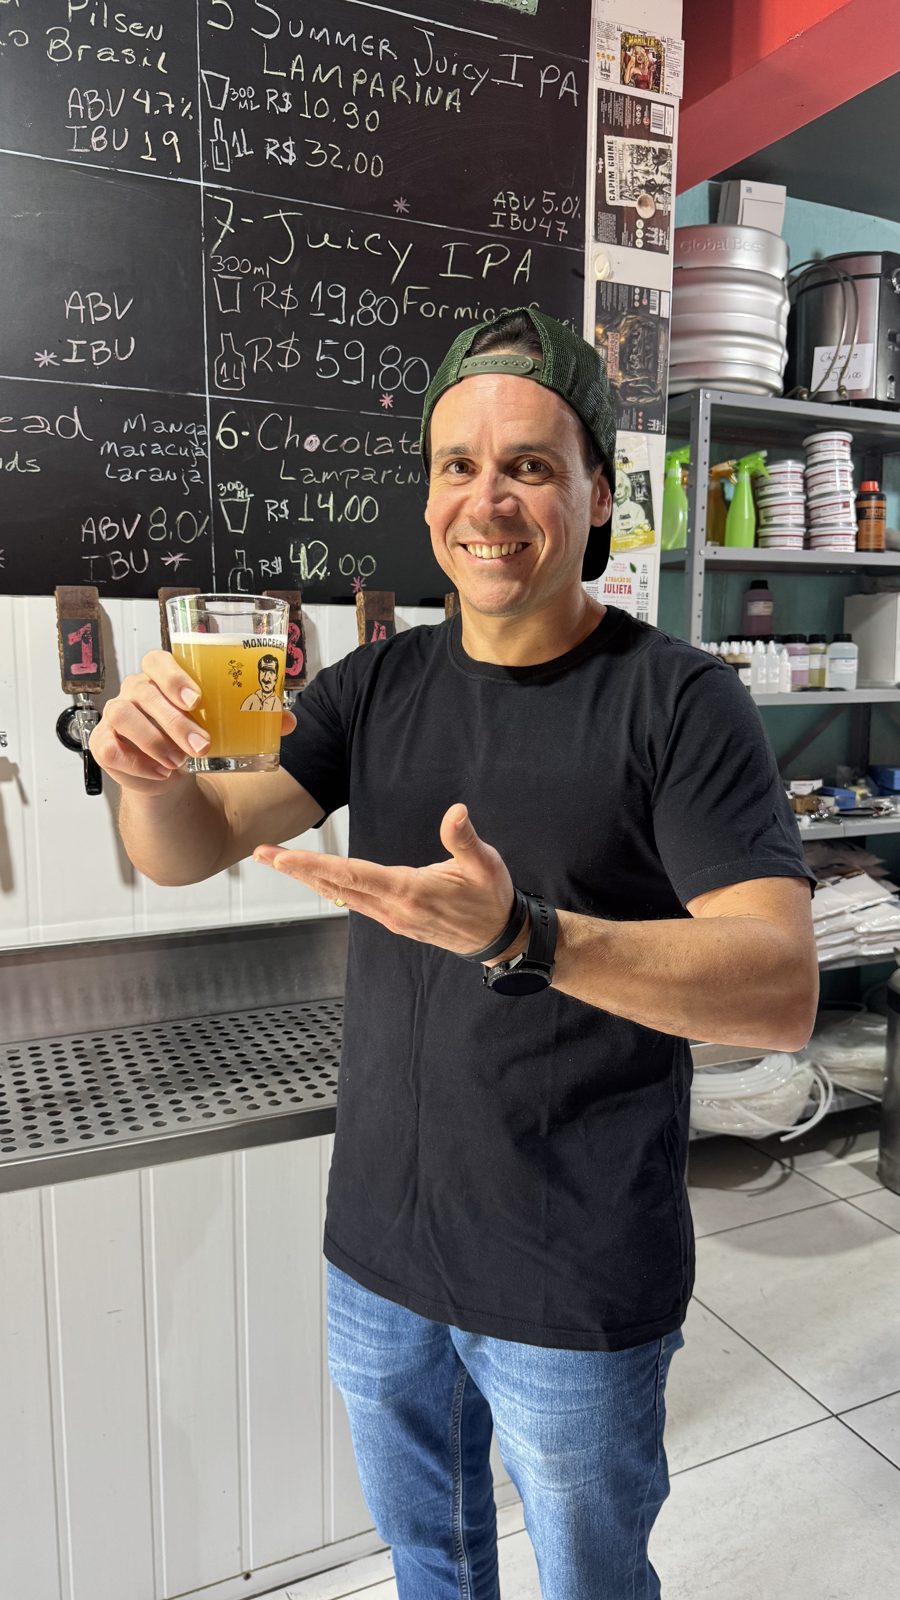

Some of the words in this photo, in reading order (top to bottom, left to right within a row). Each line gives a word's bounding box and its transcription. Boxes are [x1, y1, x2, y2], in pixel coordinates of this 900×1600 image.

[46, 27, 168, 73] Brasil
[413, 25, 490, 96] Juicy
[490, 53, 580, 107] IPA
[67, 88, 125, 122] ABV
[229, 86, 255, 101] 300
[238, 100, 261, 112] ML
[266, 88, 292, 115] R$
[65, 125, 129, 153] IBU
[140, 130, 181, 163] 19
[232, 128, 254, 158] 1L
[264, 137, 297, 166] R$
[493, 191, 536, 211] ABV
[608, 171, 616, 201] CAPIM
[488, 211, 537, 232] IBU
[538, 217, 568, 242] 47
[439, 243, 533, 285] IPA
[64, 290, 133, 324] ABV
[253, 280, 299, 318] R$
[309, 280, 399, 327] 19,80
[62, 336, 135, 365] IBU
[245, 331, 301, 373] R$
[315, 339, 430, 394] 59,80
[123, 413, 208, 446] Manga
[105, 463, 204, 495] Laranja
[217, 481, 243, 496] 300
[264, 499, 290, 523] R$
[81, 513, 141, 544] ABV
[81, 548, 149, 583] IBU
[258, 556, 282, 577] R$
[603, 583, 632, 595] JULIETA
[67, 623, 97, 675] 1
